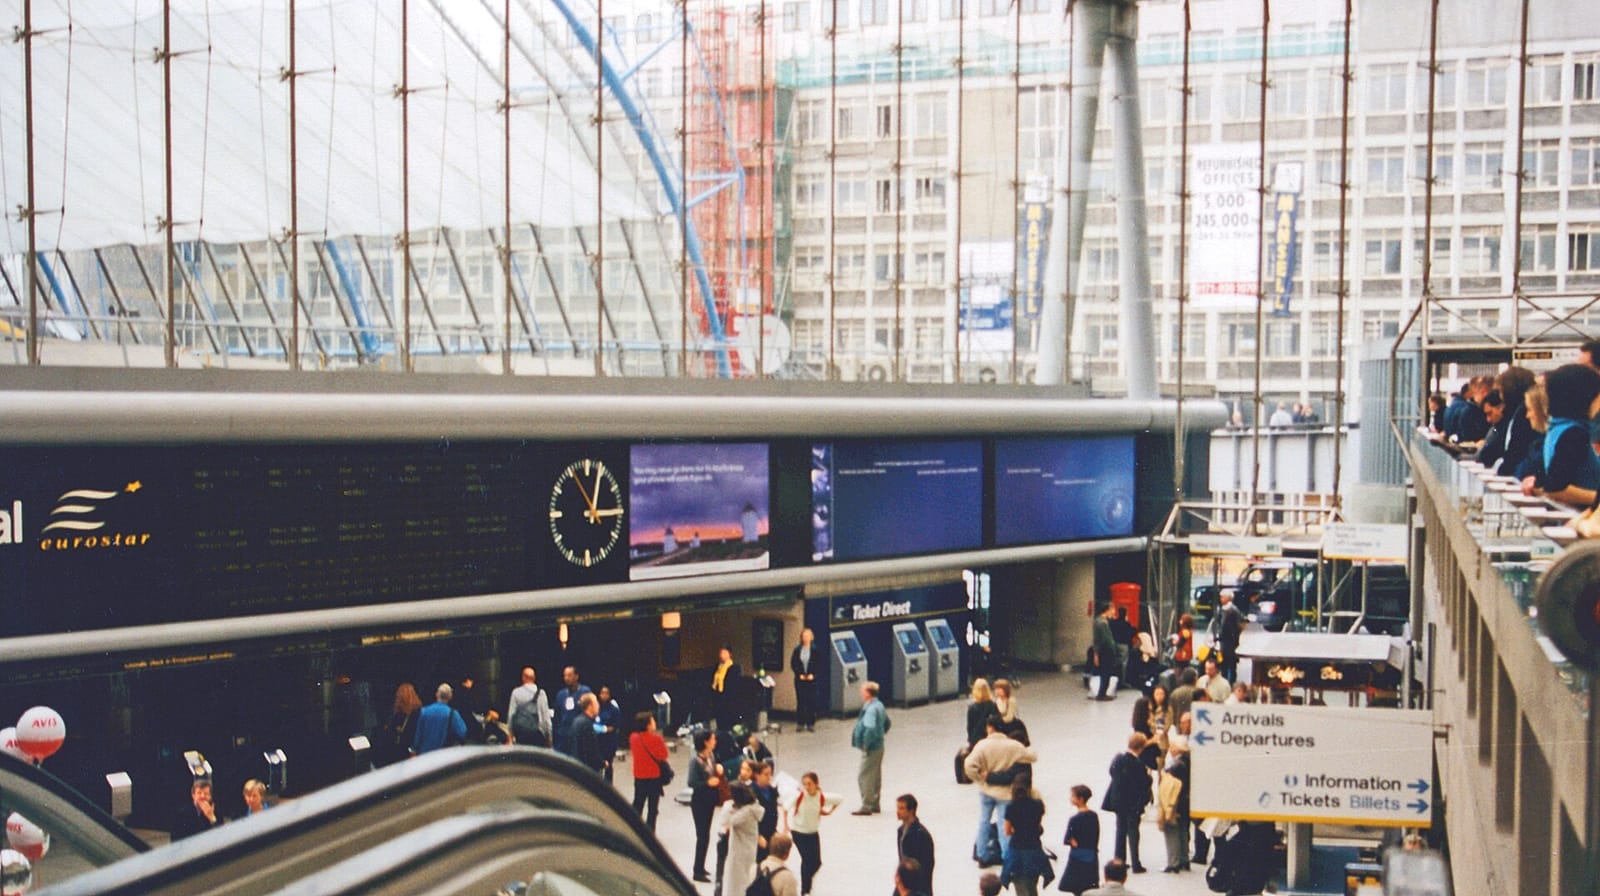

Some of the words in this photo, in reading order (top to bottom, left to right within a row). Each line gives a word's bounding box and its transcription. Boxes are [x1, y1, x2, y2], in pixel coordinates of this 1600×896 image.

[1203, 172, 1254, 185] OFFICES
[1027, 204, 1042, 314] MANSELL
[1275, 194, 1294, 310] MANSELL
[40, 533, 150, 550] eurostar
[852, 604, 881, 619] Ticket
[882, 601, 911, 617] Direct
[1267, 665, 1305, 683] Coffee
[1319, 666, 1344, 681] Bar
[32, 717, 57, 728] AVIS
[1222, 711, 1285, 728] Arrivals
[1220, 731, 1316, 748] Departures
[1305, 773, 1402, 791] Information
[1280, 792, 1341, 809] Tickets
[1349, 796, 1401, 811] Billets
